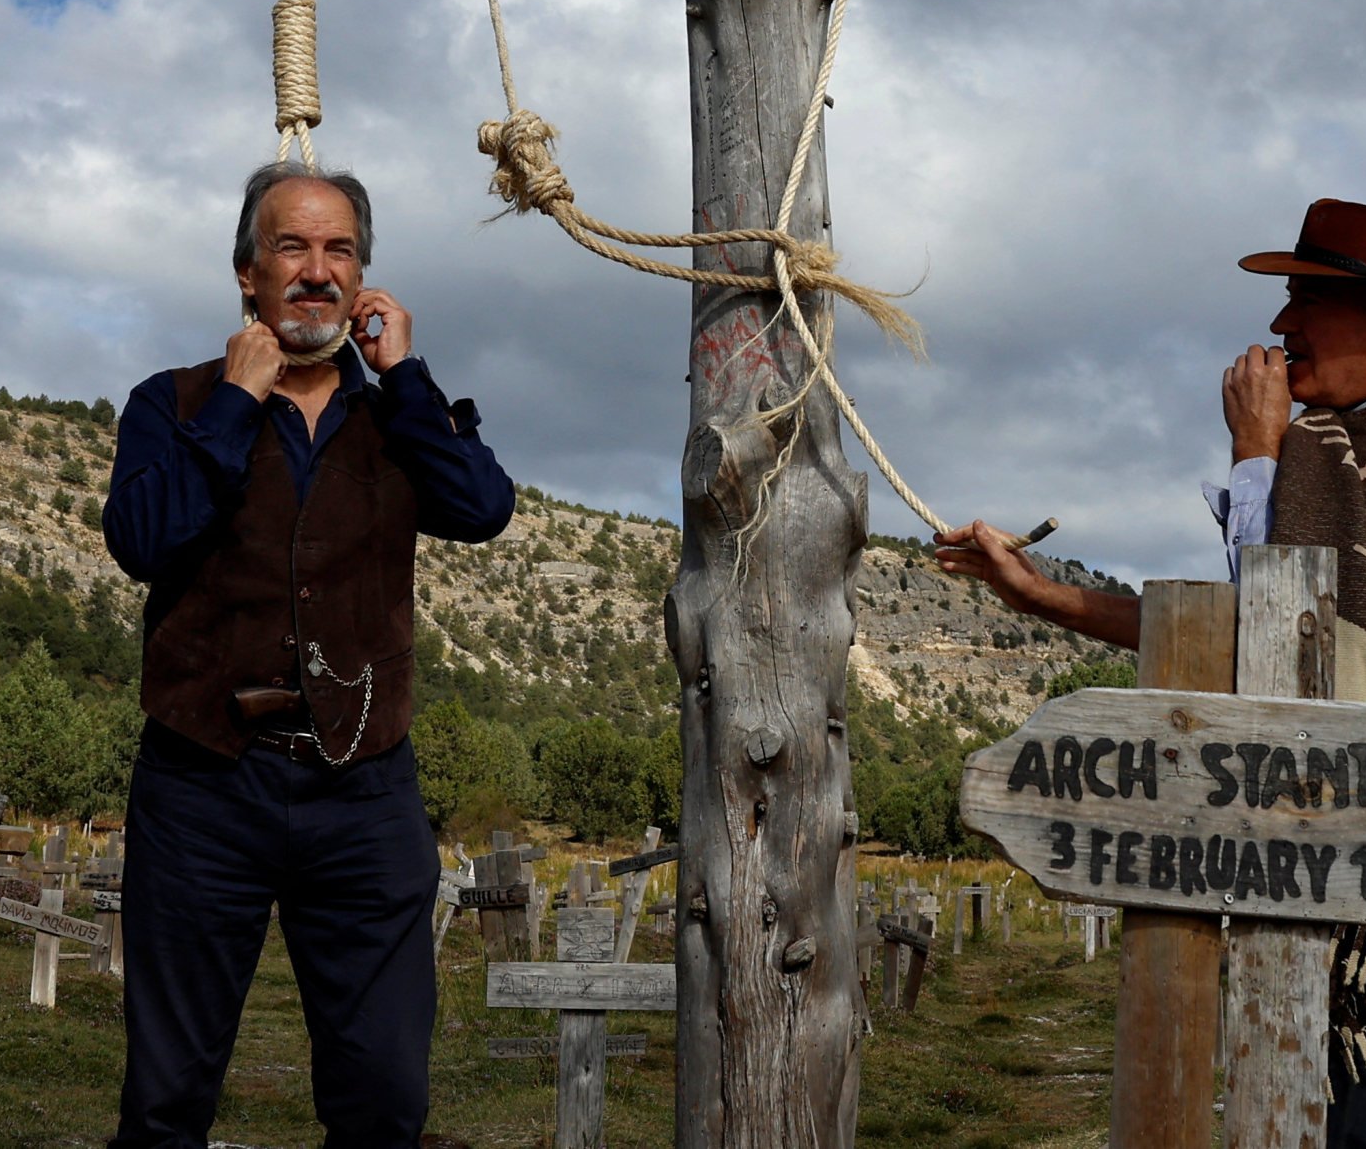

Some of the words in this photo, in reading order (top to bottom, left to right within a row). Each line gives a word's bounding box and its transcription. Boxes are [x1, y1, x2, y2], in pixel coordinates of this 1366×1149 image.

[1007, 736, 1158, 802] ARCH
[1049, 821, 1076, 870] 3
[1089, 829, 1337, 904] FEBRUARY
[1, 902, 33, 921] DAVID
[460, 888, 516, 905] GUILLE
